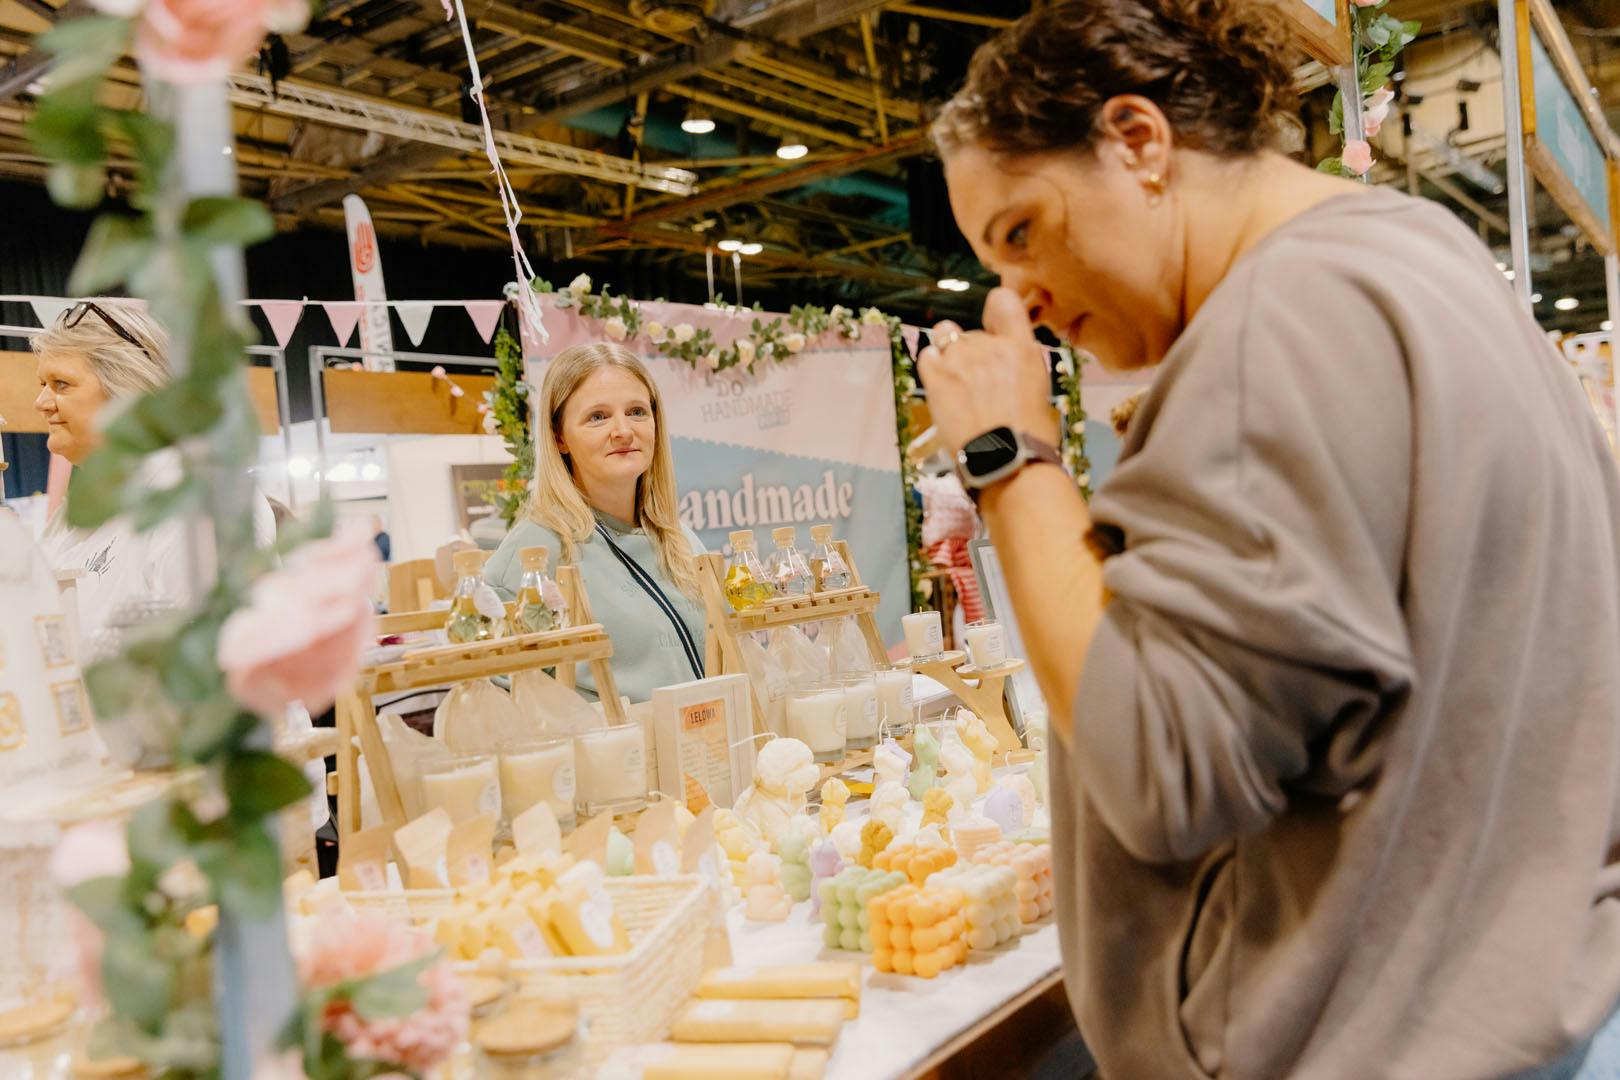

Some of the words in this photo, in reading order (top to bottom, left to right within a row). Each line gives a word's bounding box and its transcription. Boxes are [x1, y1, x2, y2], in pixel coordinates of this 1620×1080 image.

[716, 379, 745, 397] DO
[701, 389, 795, 424] HANDMADE
[678, 469, 853, 531] andmade
